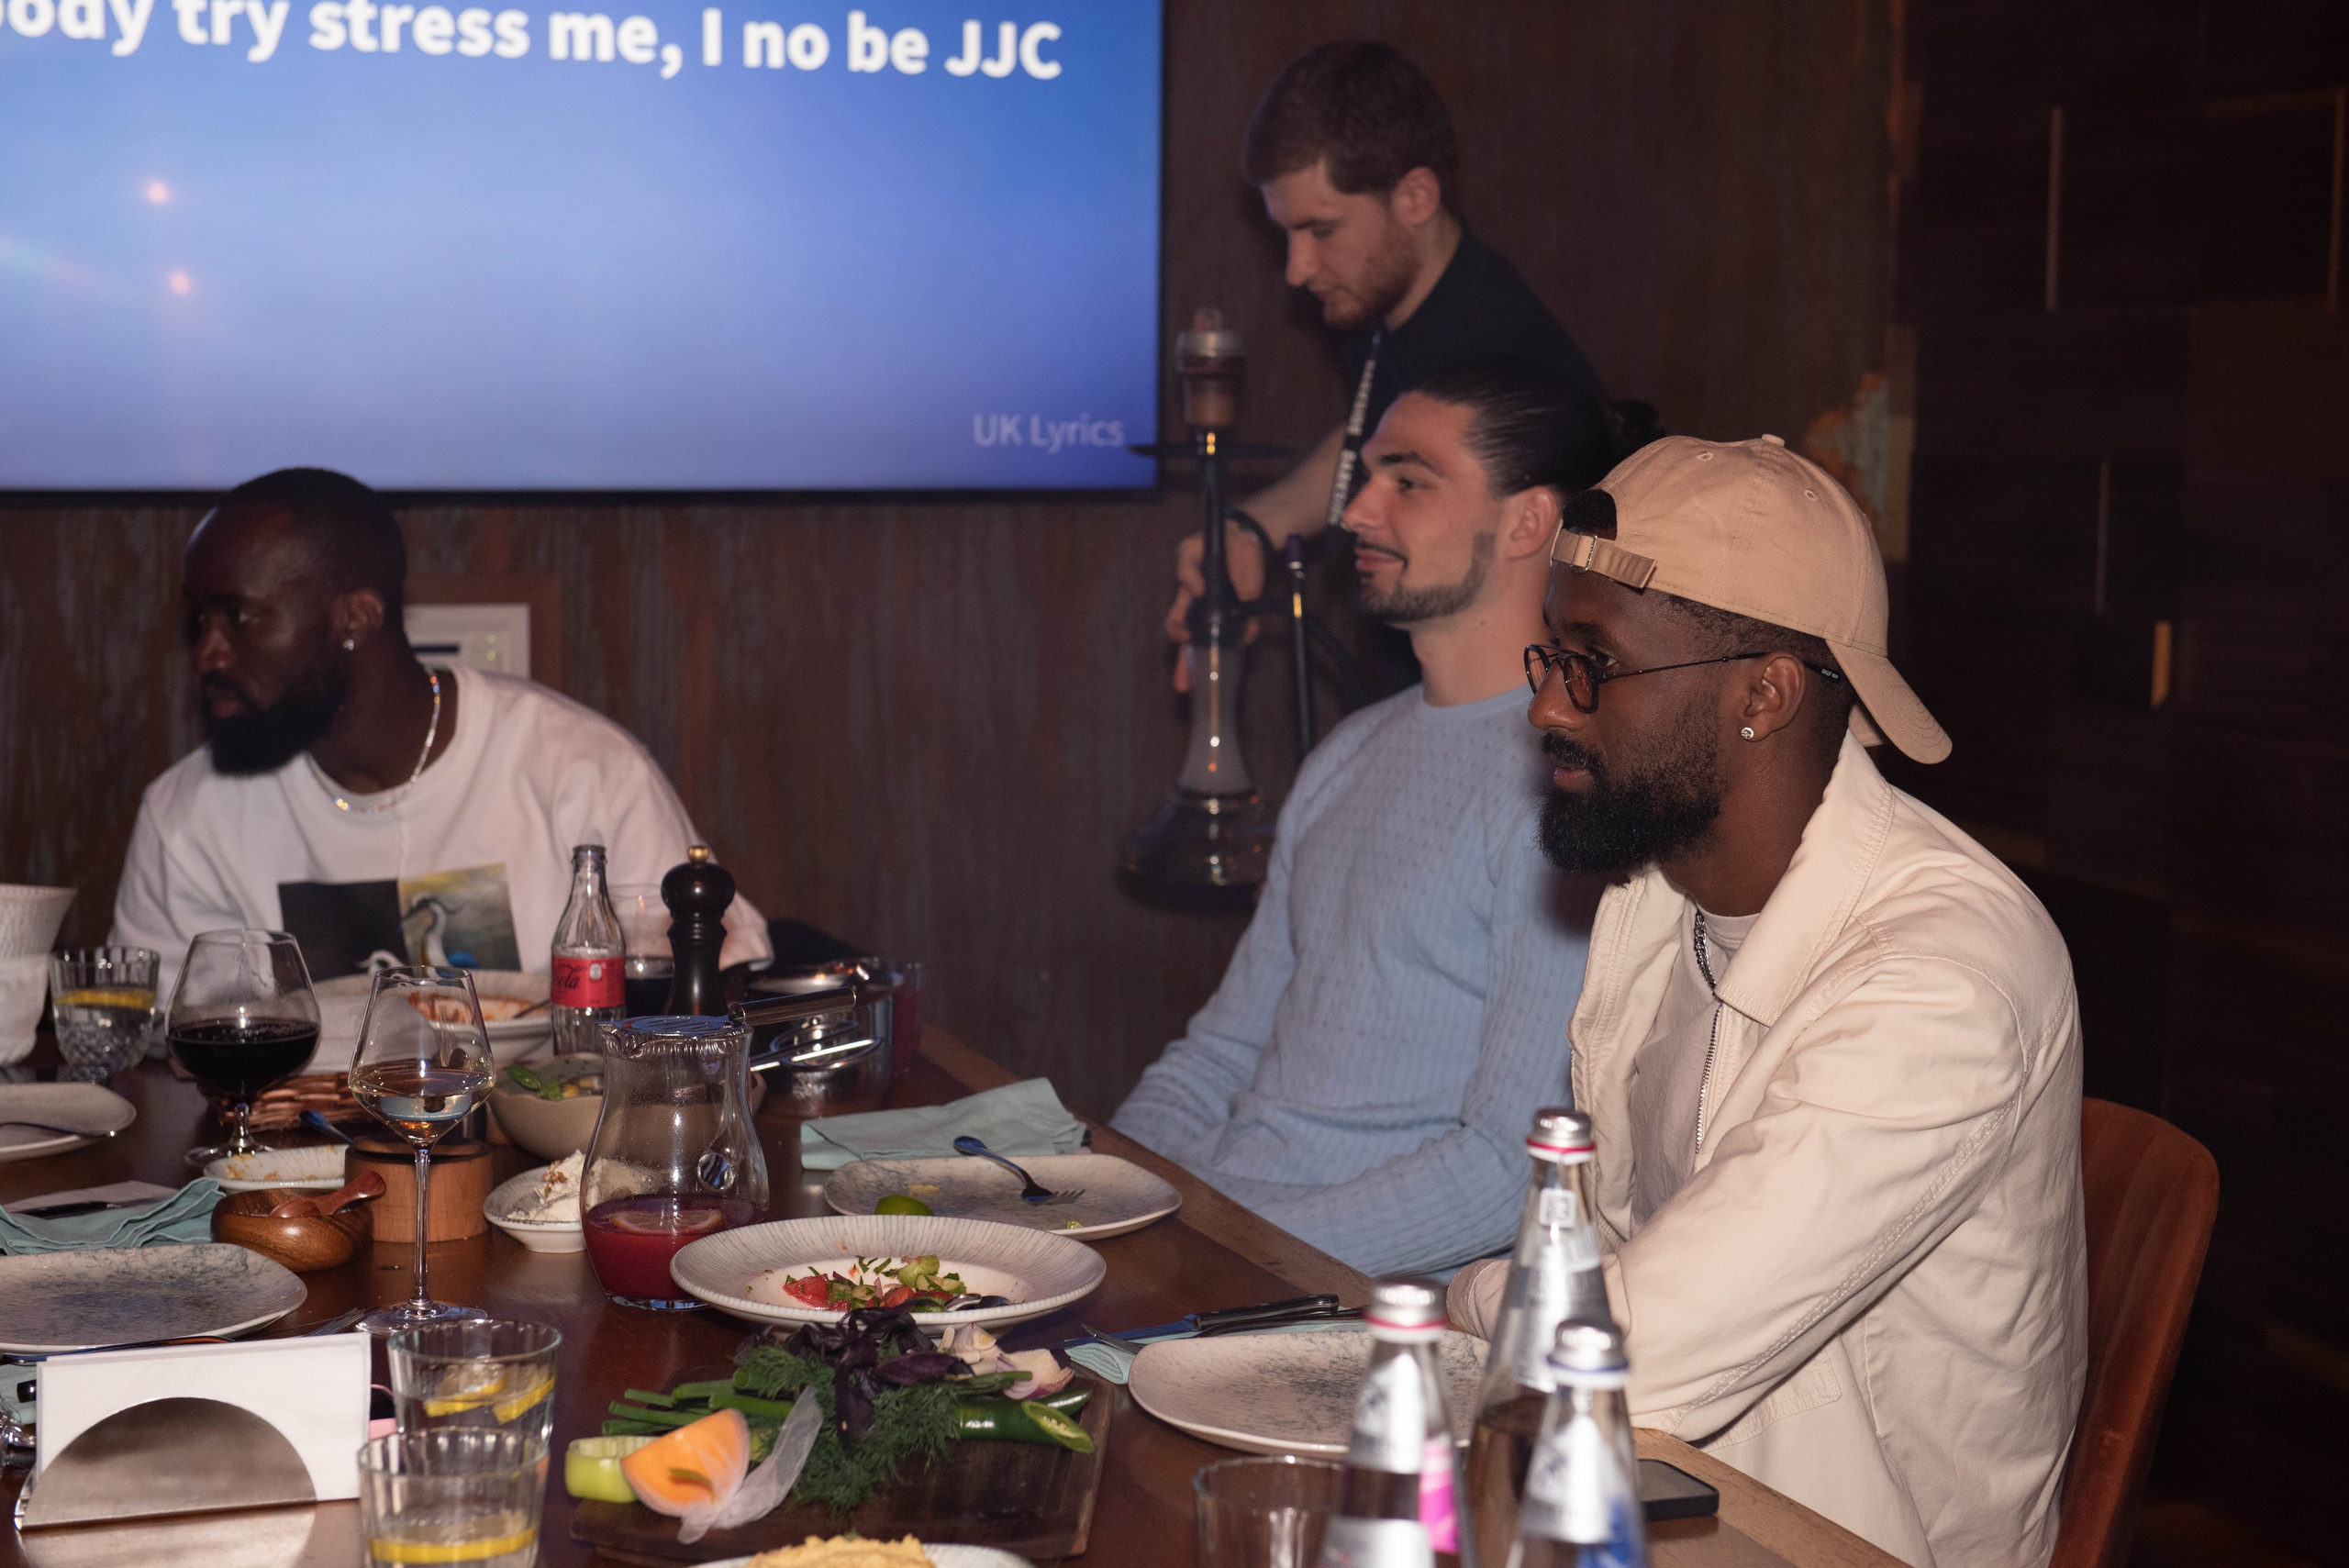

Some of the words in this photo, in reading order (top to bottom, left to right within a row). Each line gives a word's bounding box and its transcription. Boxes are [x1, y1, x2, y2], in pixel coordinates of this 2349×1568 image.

[0, 0, 155, 57] ody
[172, 0, 291, 64] try
[307, 0, 531, 60] stress
[548, 12, 684, 80] me,
[702, 7, 723, 67] I
[742, 21, 829, 71] no
[848, 11, 929, 74] be
[944, 19, 1062, 80] JJC
[973, 414, 1023, 447] UK
[1030, 413, 1126, 455] Lyrics
